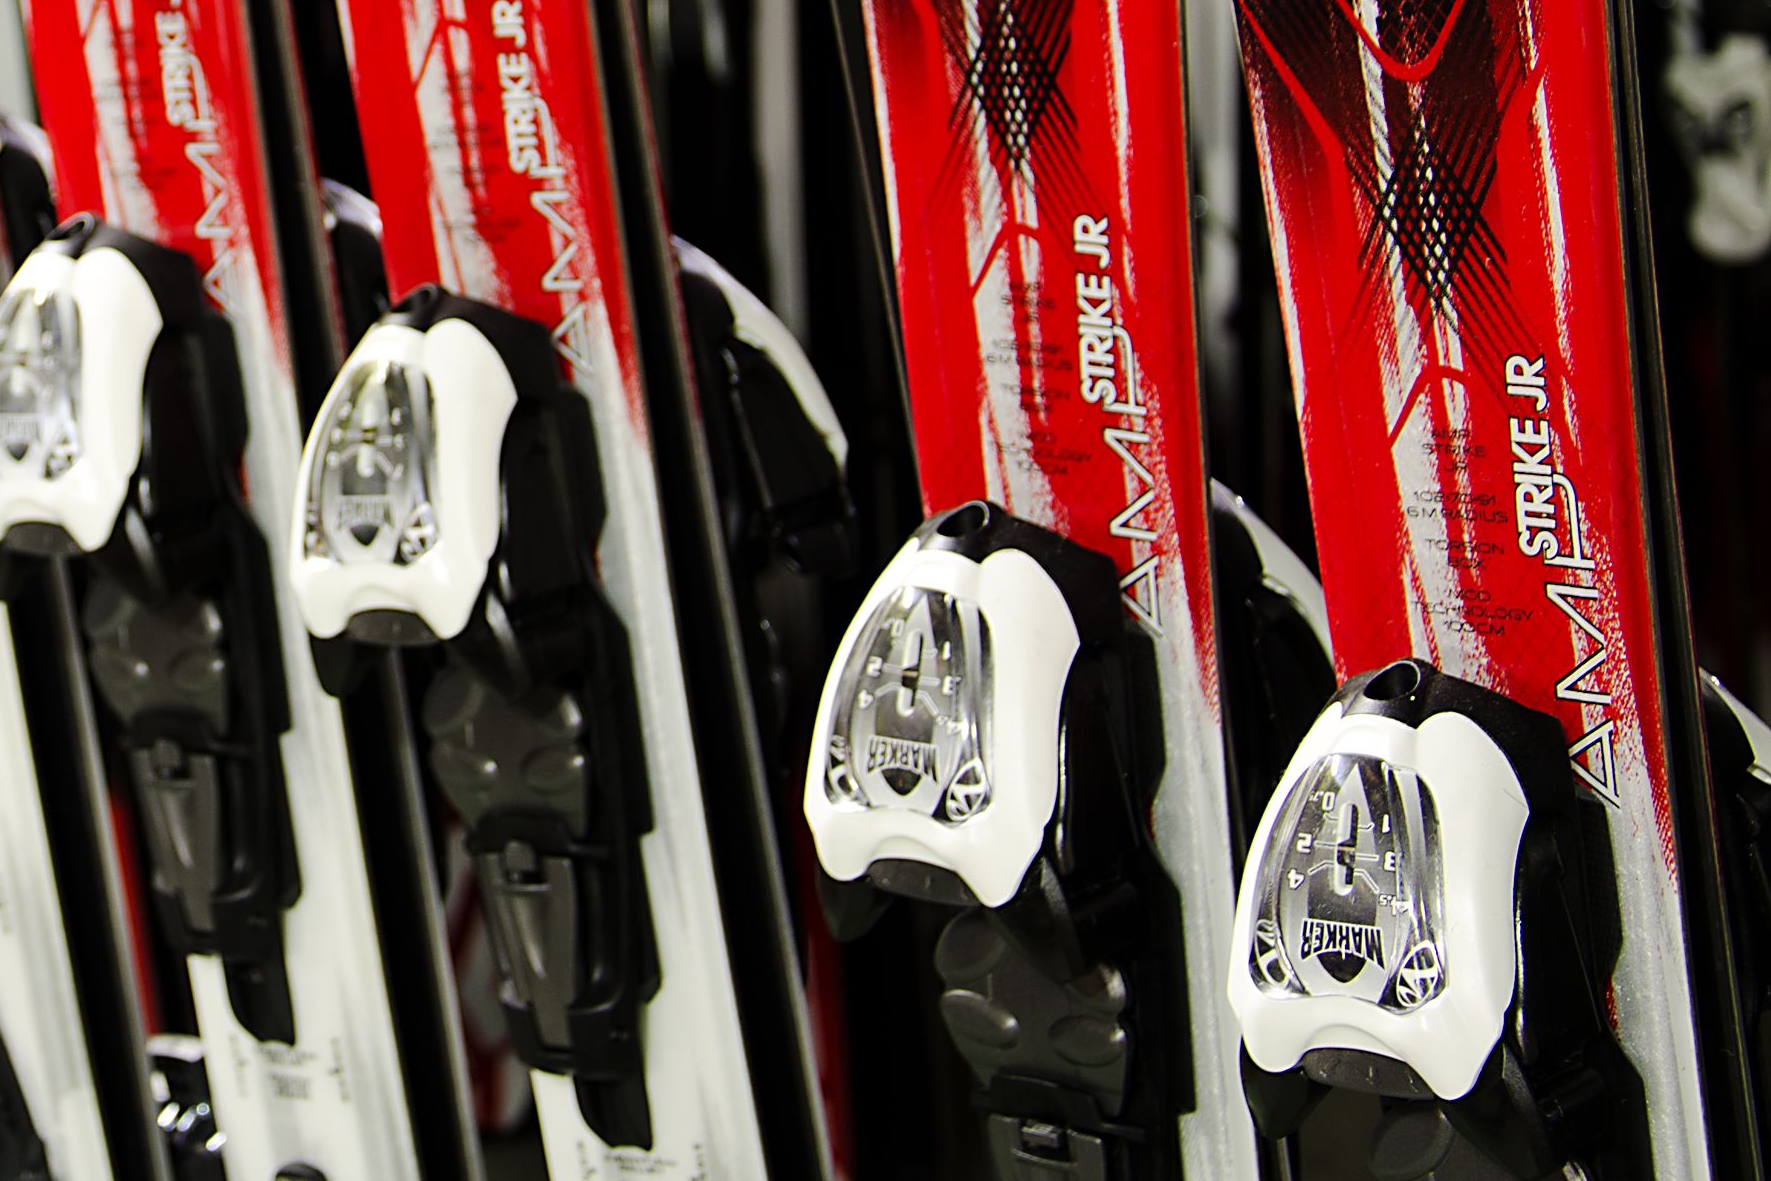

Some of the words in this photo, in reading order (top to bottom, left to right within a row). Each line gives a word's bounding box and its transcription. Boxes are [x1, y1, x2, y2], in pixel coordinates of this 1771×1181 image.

[497, 52, 540, 174] STRIKE
[1073, 213, 1109, 269] JR
[1076, 270, 1117, 406] STRIKE
[1504, 353, 1548, 412] JR
[1509, 416, 1559, 560] STRIKE
[1410, 601, 1534, 620] TECHNOLOGY
[867, 734, 941, 785] MARKER
[1297, 833, 1312, 854] 2
[1381, 813, 1391, 834] 1
[1287, 868, 1305, 891] 4
[1383, 851, 1397, 872] 3
[1299, 918, 1386, 970] MARKER
